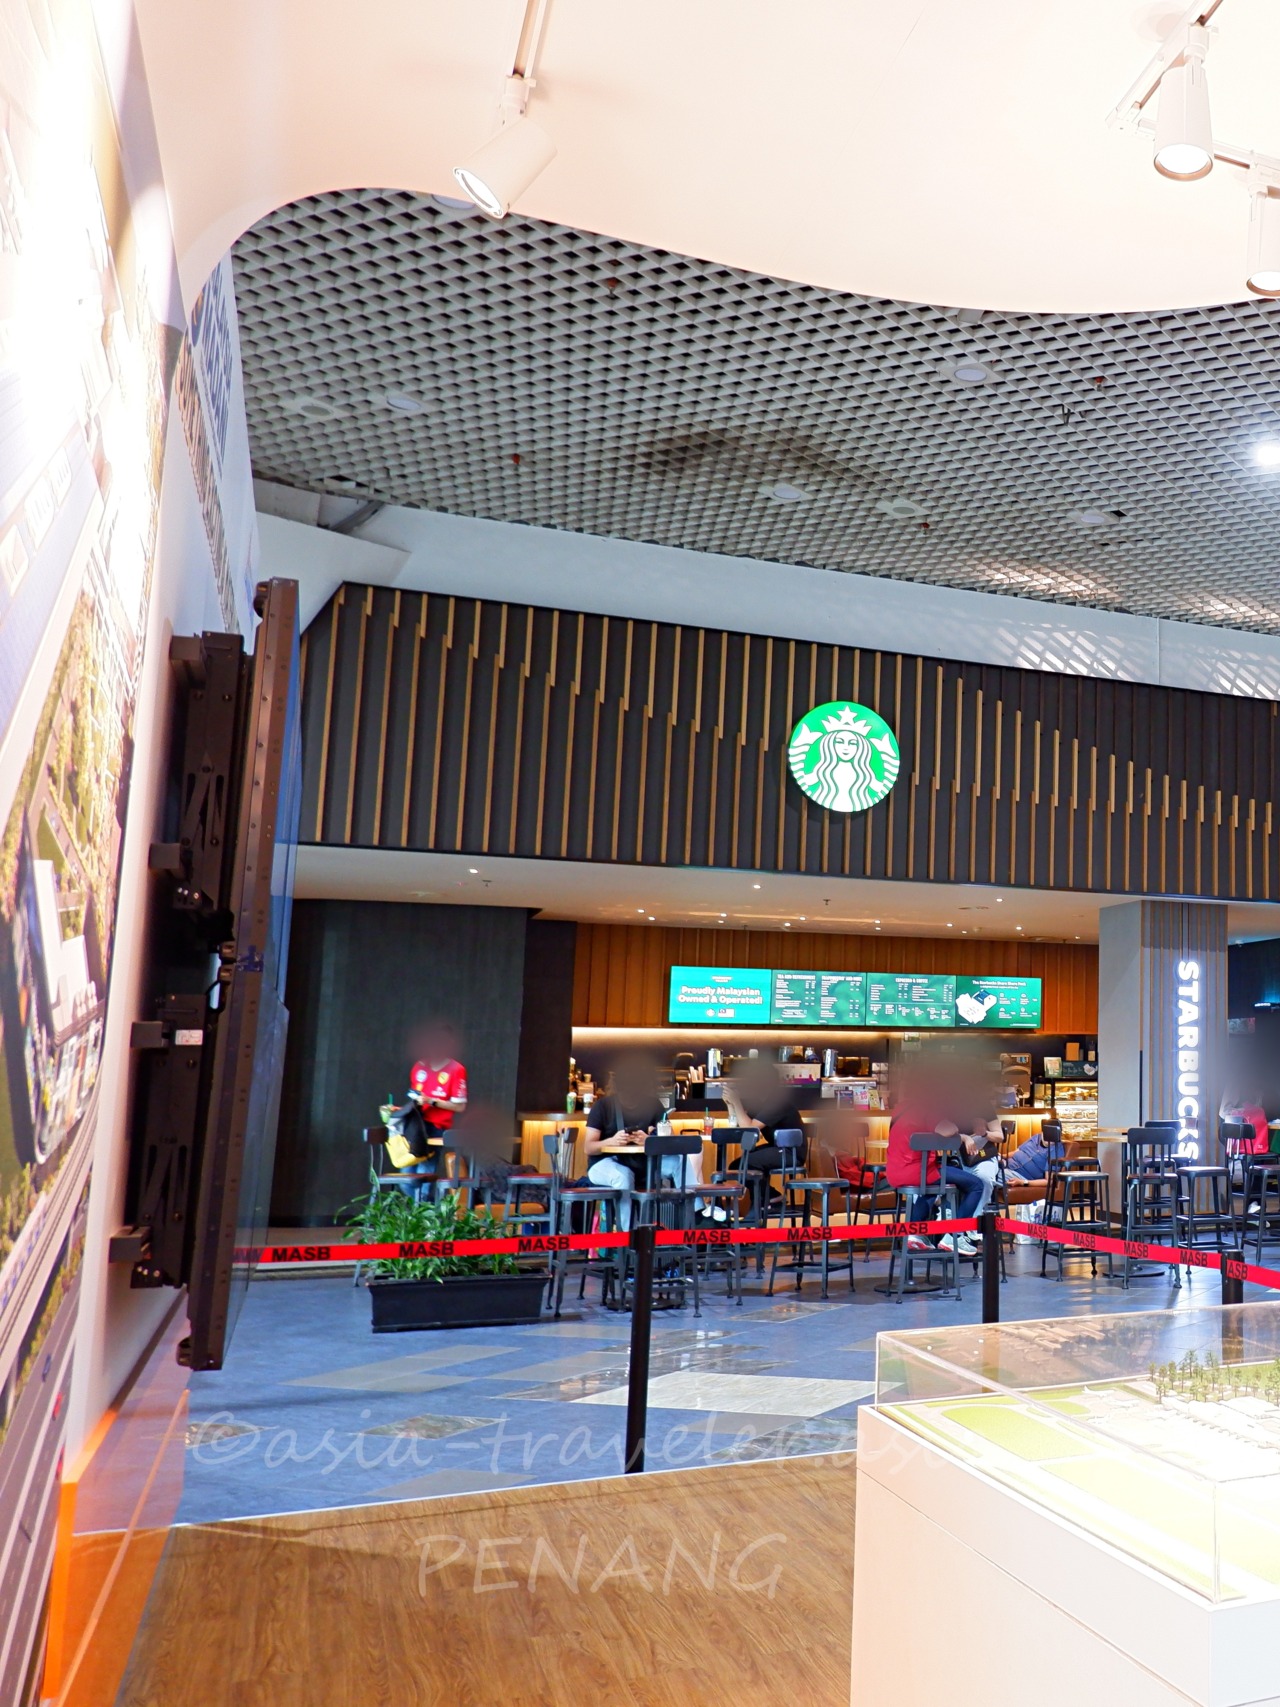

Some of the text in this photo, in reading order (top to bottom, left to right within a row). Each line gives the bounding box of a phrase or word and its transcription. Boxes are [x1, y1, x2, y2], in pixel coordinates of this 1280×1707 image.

[678, 994, 710, 1004] Owned
[718, 996, 763, 1006] Operated!
[681, 985, 761, 998] Proudly Malaysian
[1177, 960, 1200, 1160] STARBUCKS
[684, 1222, 928, 1243] MASB MASB MASB
[272, 1247, 331, 1263] MASB
[399, 1242, 455, 1259] MASB
[518, 1236, 570, 1252] MASB
[1027, 1223, 1048, 1239] MASB
[1073, 1232, 1096, 1248] MASB
[1124, 1241, 1149, 1258] MASB
[1180, 1249, 1208, 1267] MASB
